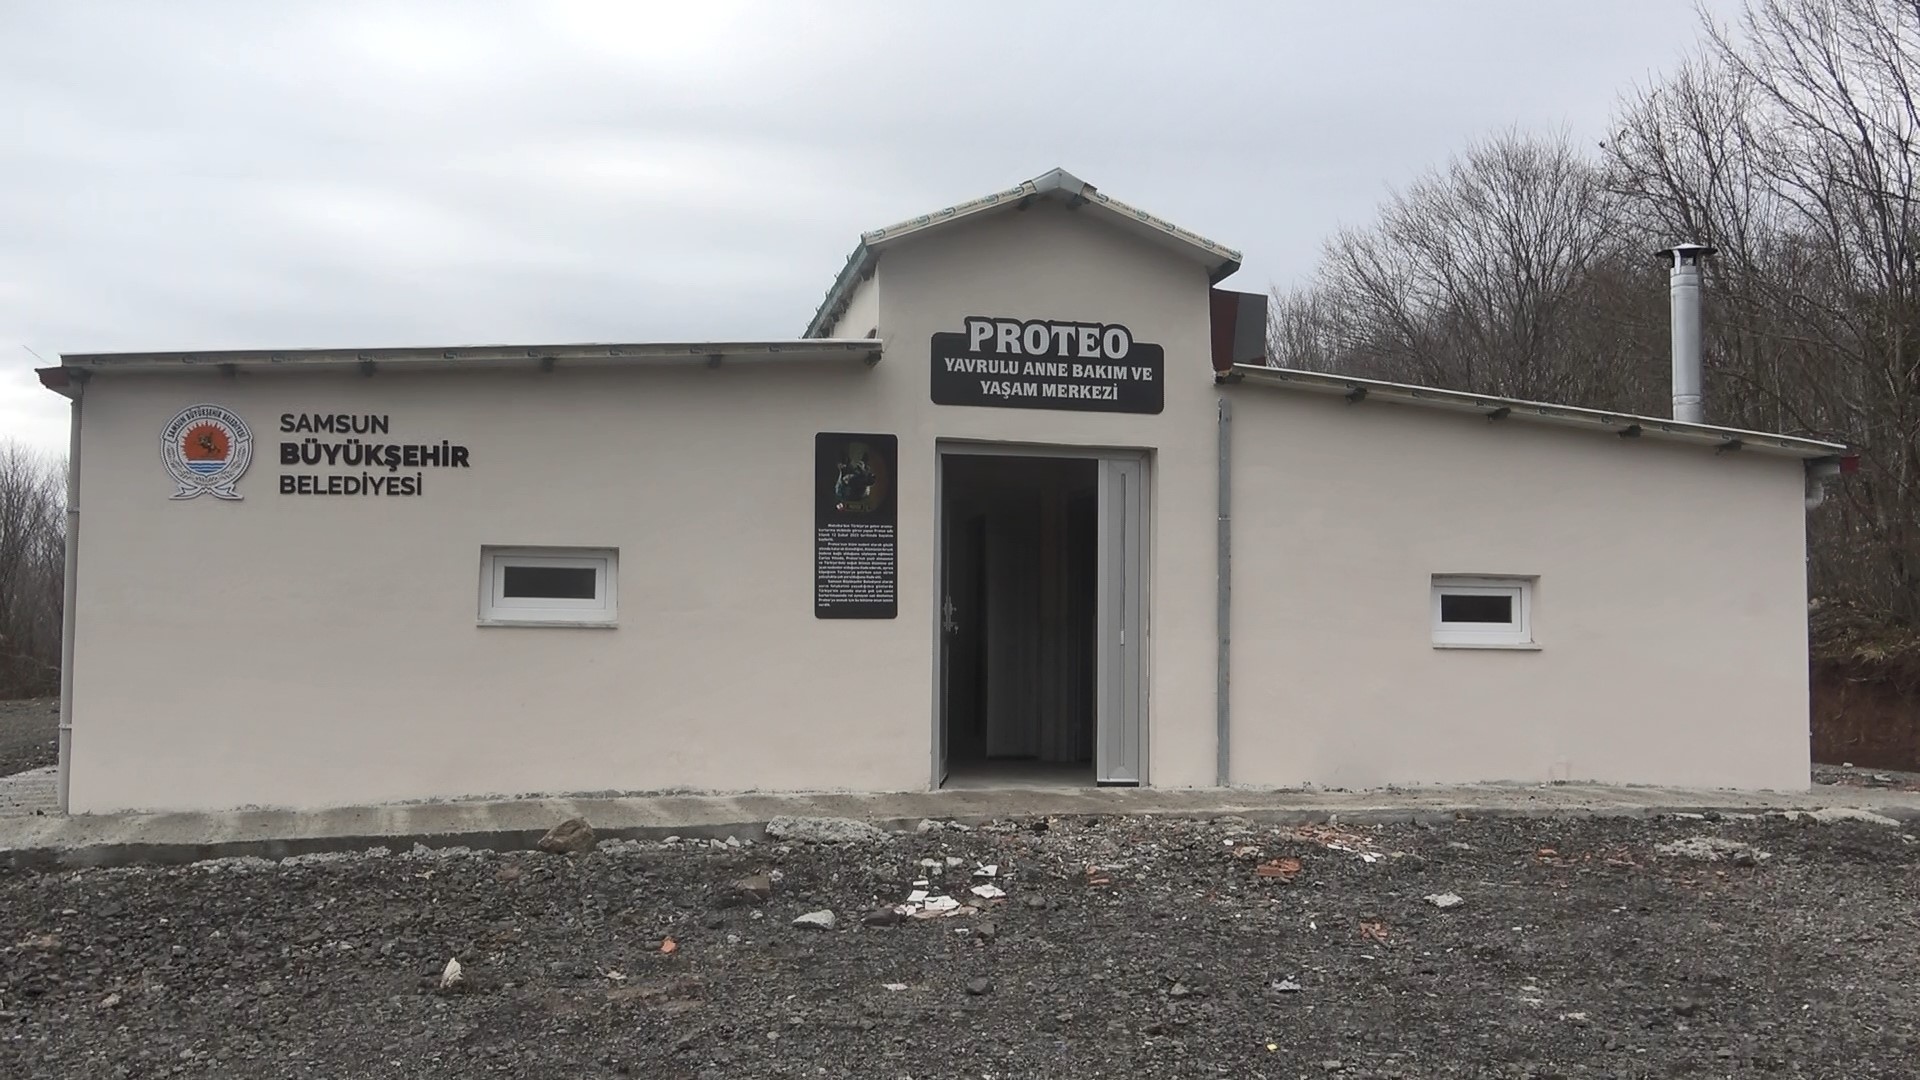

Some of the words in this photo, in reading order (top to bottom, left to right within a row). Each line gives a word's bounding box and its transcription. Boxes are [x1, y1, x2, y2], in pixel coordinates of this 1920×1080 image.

[970, 321, 1129, 359] PROTEO
[944, 357, 1019, 375] YAVRULU
[1023, 362, 1068, 377] ANNE
[1072, 364, 1128, 380] BAKIM
[1131, 367, 1153, 381] VE
[980, 381, 1038, 400] YAŞAM
[1042, 383, 1118, 400] MERKEZİ
[167, 416, 188, 439] SAMSUN
[280, 413, 389, 434] SAMSUN
[280, 438, 470, 472] BÜYÜKŞEHİR
[280, 471, 422, 496] BELEDİYESİ
